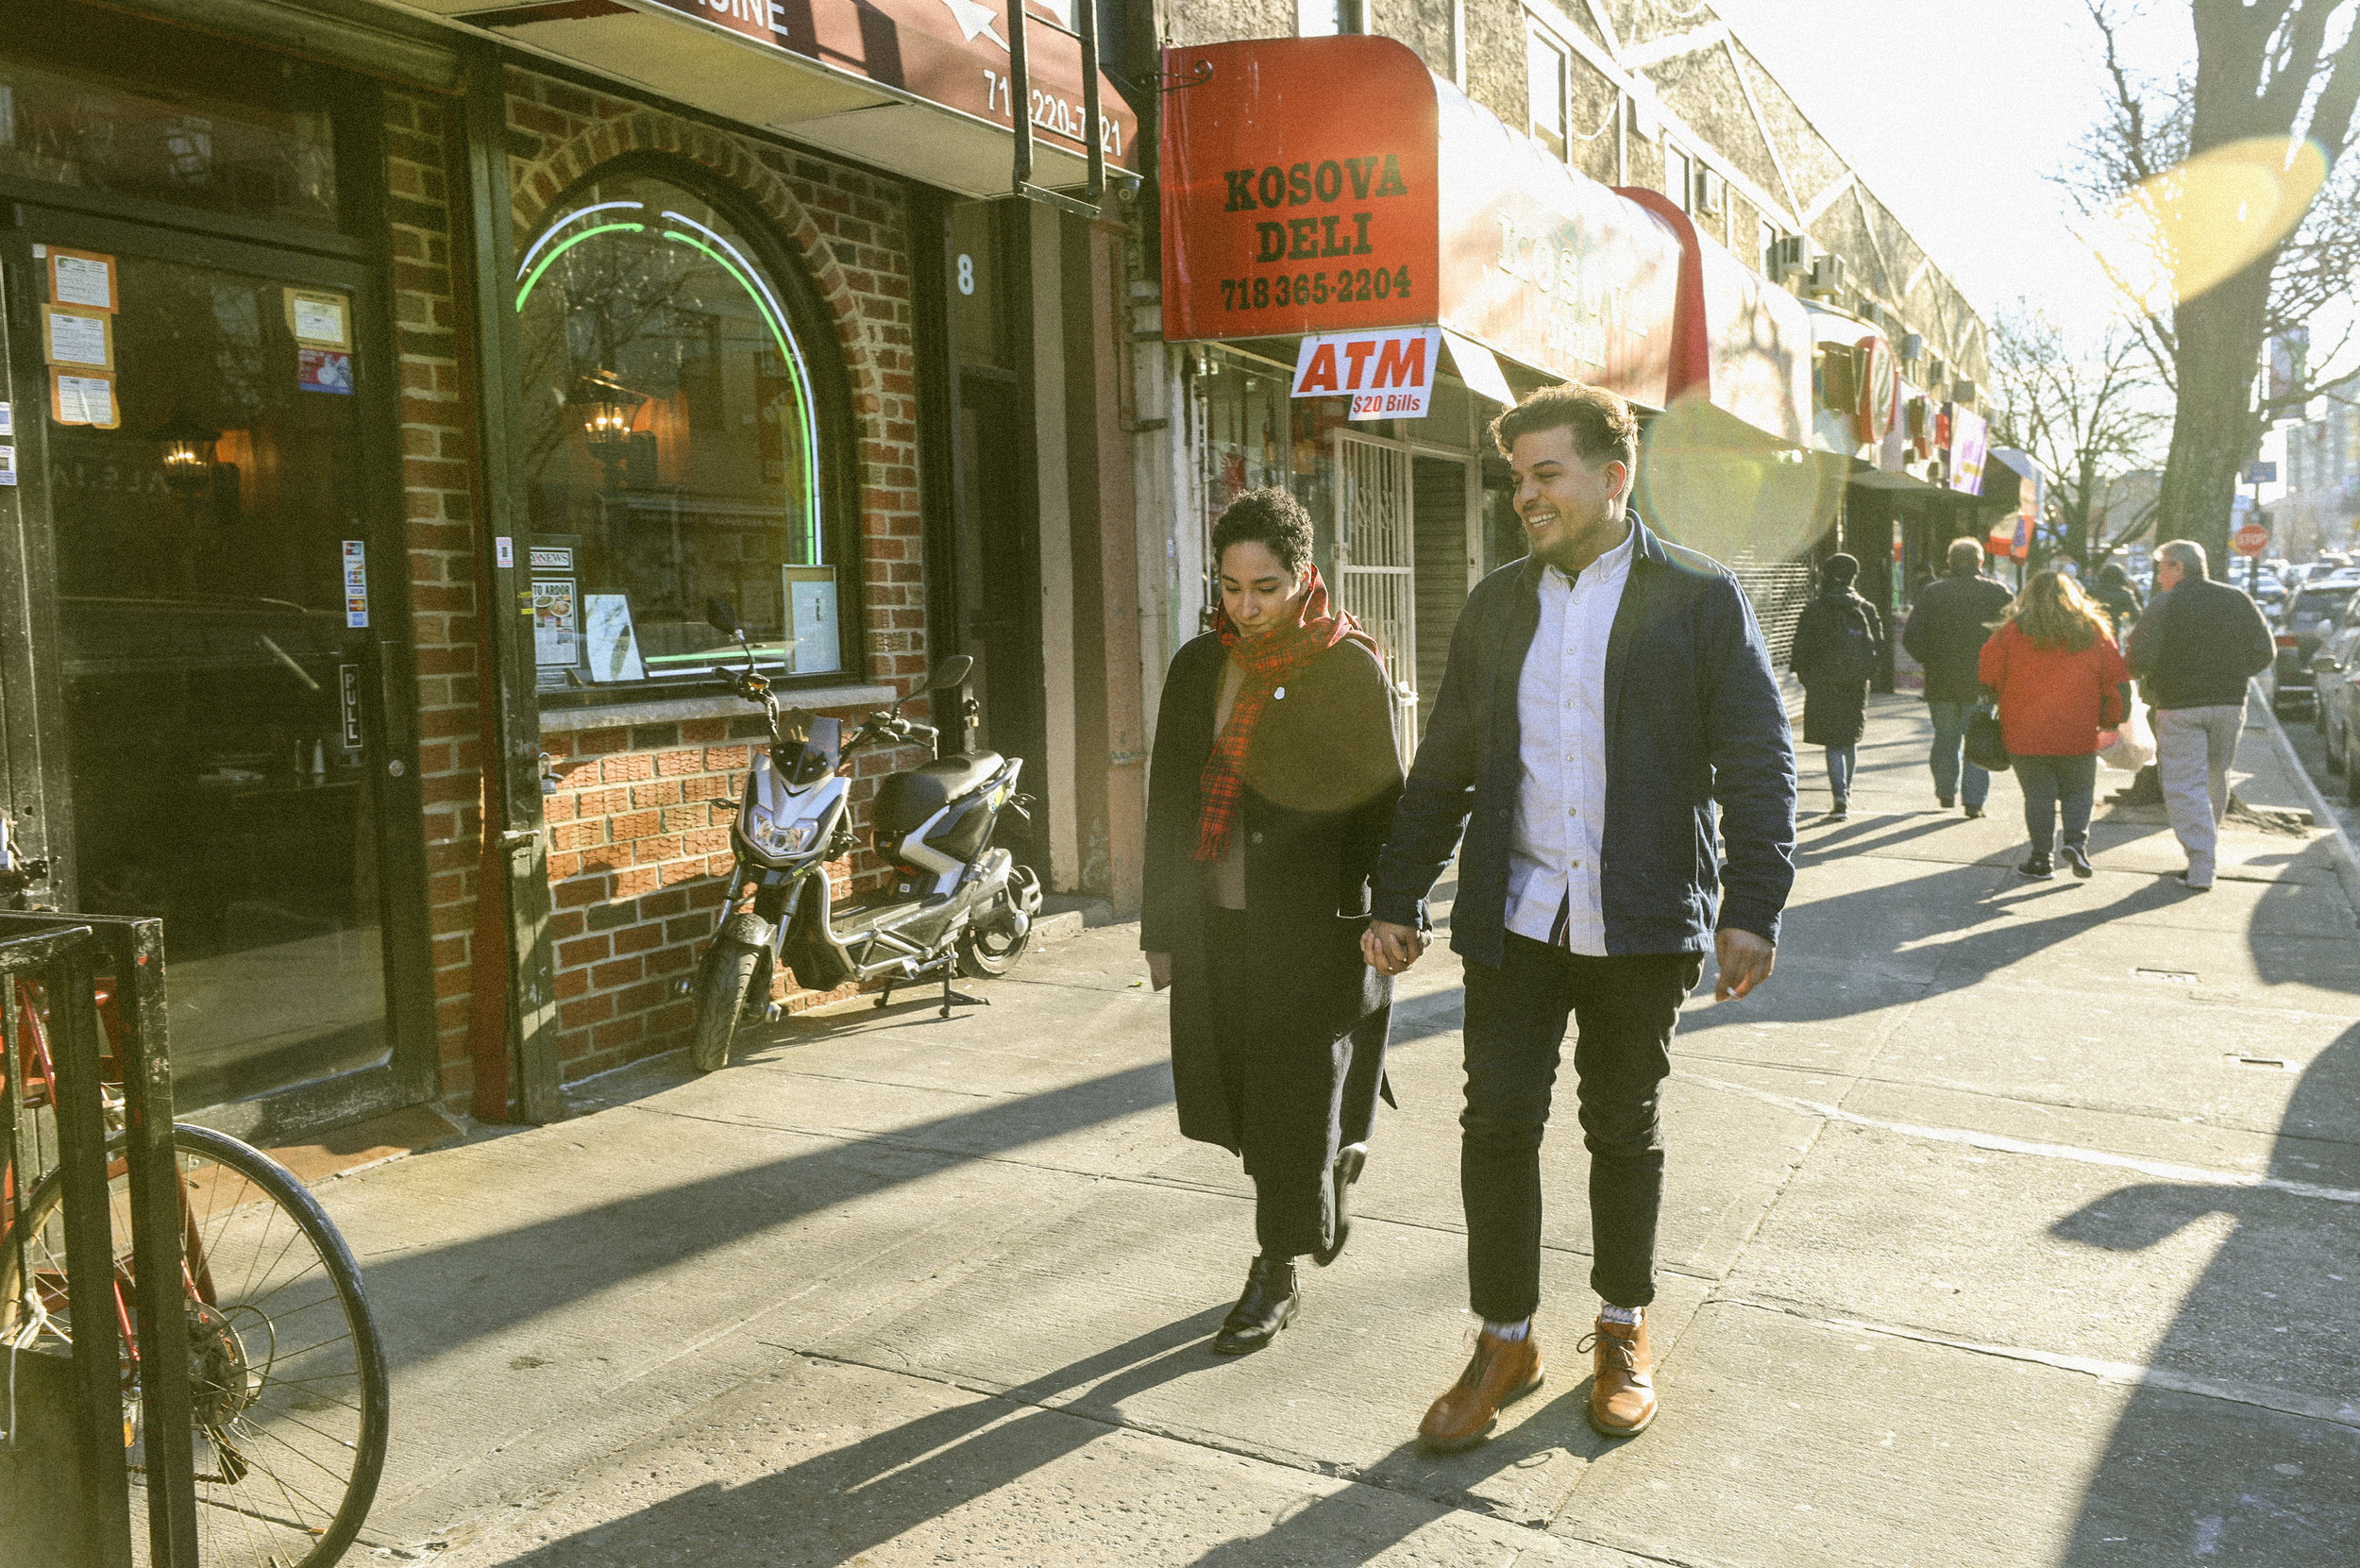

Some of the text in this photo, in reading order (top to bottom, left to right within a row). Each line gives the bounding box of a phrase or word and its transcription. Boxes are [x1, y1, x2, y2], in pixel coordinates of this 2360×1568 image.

[983, 69, 1121, 157] 71-220-721
[1223, 154, 1408, 212] KOSOVA
[1256, 212, 1373, 263] DELI
[957, 254, 974, 295] 8
[1298, 338, 1426, 393] ATM
[1353, 395, 1421, 413] $20 Bills
[538, 553, 568, 563] NEWS
[2236, 532, 2267, 546] STOP
[532, 585, 543, 596] TO
[346, 673, 358, 739] PULL
